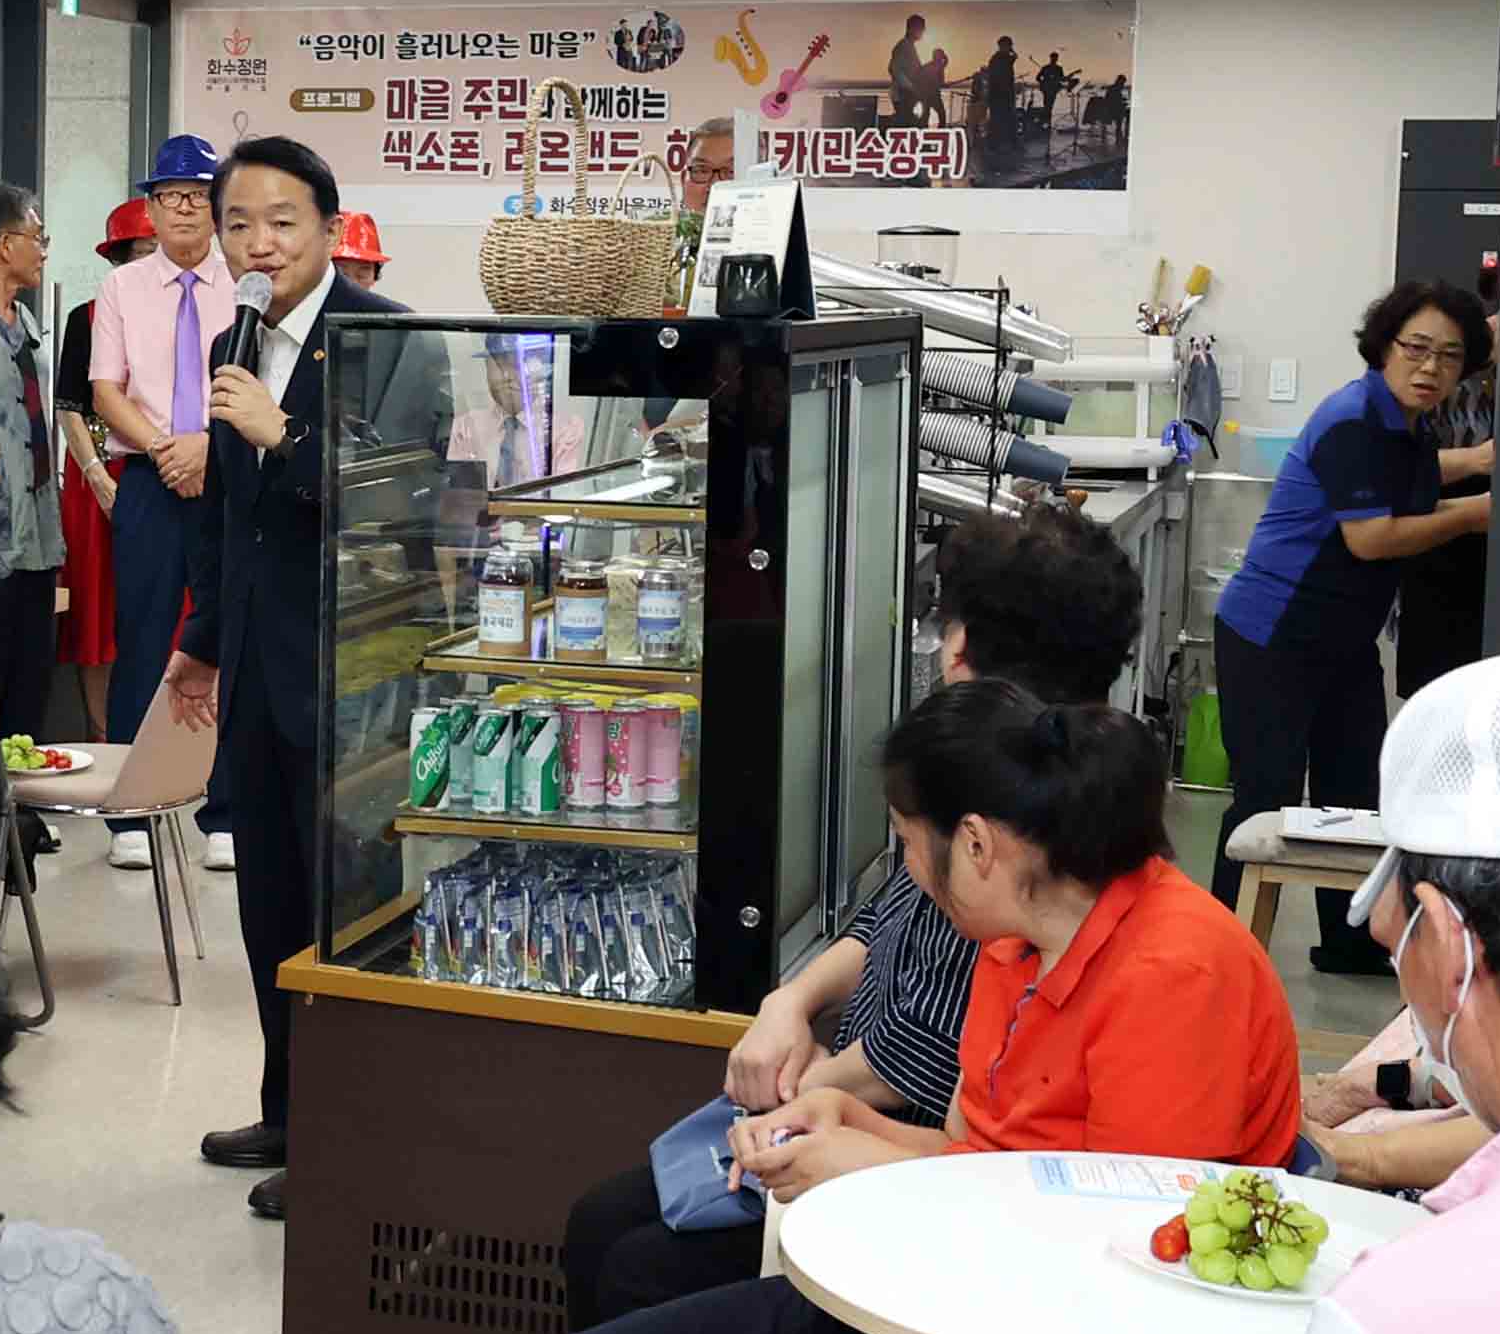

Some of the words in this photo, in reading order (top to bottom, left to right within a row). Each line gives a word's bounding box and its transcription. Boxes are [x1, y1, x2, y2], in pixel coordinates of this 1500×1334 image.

[299, 33, 385, 61] “음악이
[396, 32, 521, 60] 흘러나오는
[529, 31, 595, 59] 마을”
[207, 58, 267, 76] 화수정원
[303, 91, 361, 108] 프로그램
[386, 78, 450, 120] 마을
[383, 130, 492, 177] 색소폰,
